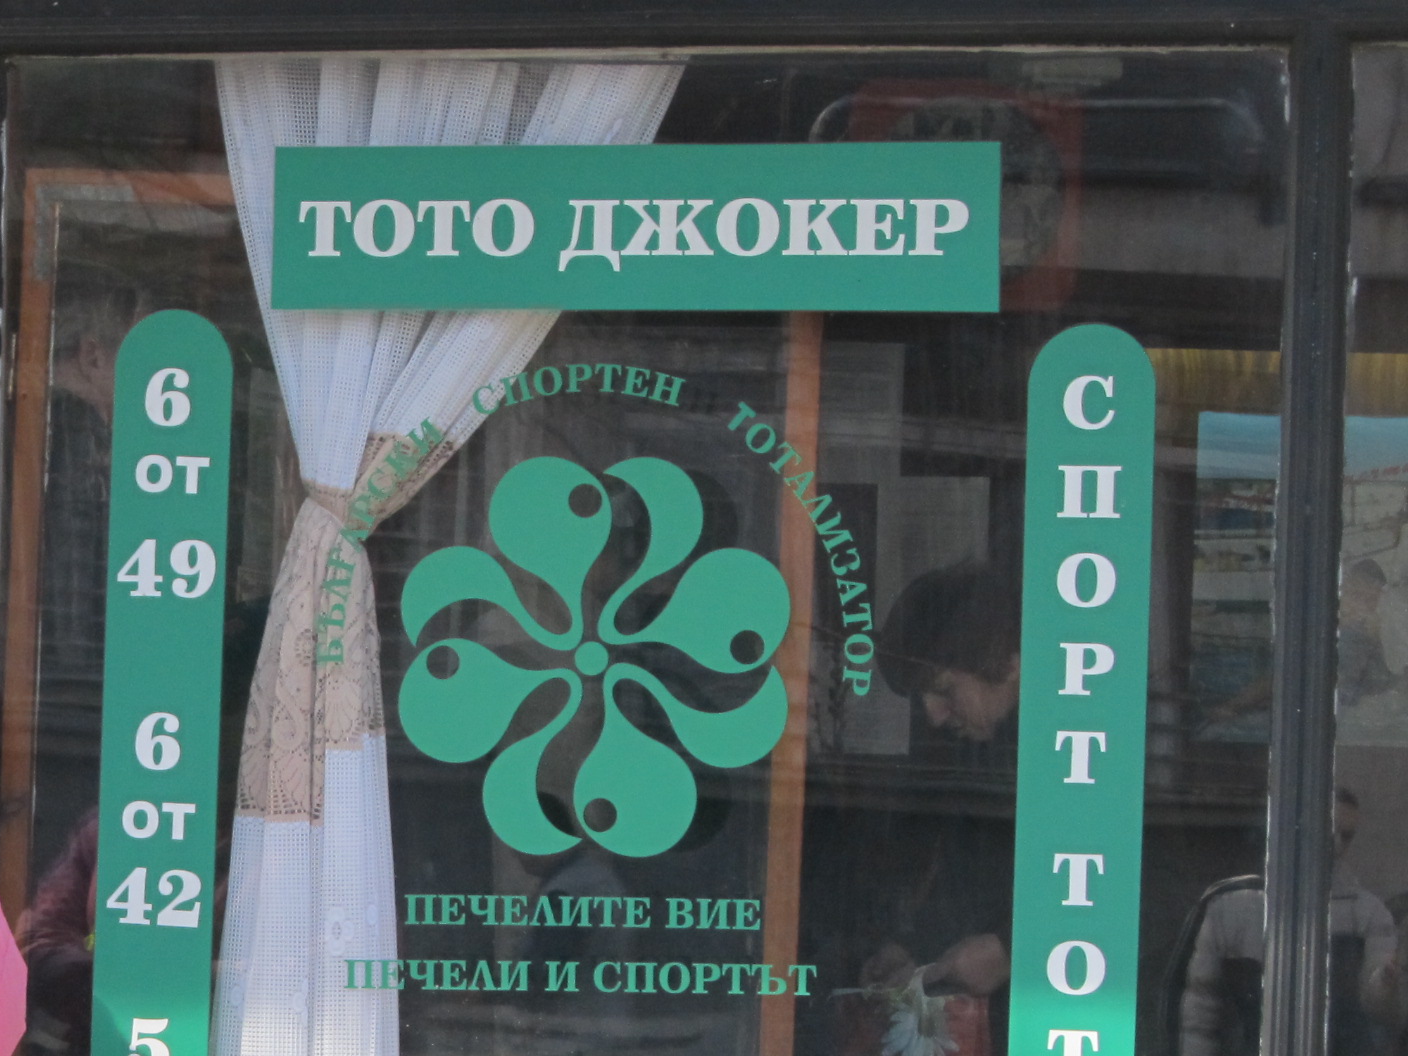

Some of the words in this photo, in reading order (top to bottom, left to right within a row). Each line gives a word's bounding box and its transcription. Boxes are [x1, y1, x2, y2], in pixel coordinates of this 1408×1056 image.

[299, 198, 535, 258] ТОТО
[558, 197, 970, 273] ДЖОКЕР
[144, 367, 191, 427] 6
[472, 363, 686, 416] СПОРТЕН
[117, 538, 217, 599] 49
[727, 401, 875, 697] ТОТАЛИЗАТОР
[1055, 375, 1123, 784] СПОРТ
[134, 711, 181, 771] 6
[106, 867, 202, 928] 42
[404, 894, 651, 929] ПЕЧЕЛИТЕ
[665, 897, 761, 931] ВИЕ
[343, 958, 531, 992] ПЕЧЕЛИ
[544, 960, 580, 992] И
[593, 961, 817, 996] СПОРТЪТ
